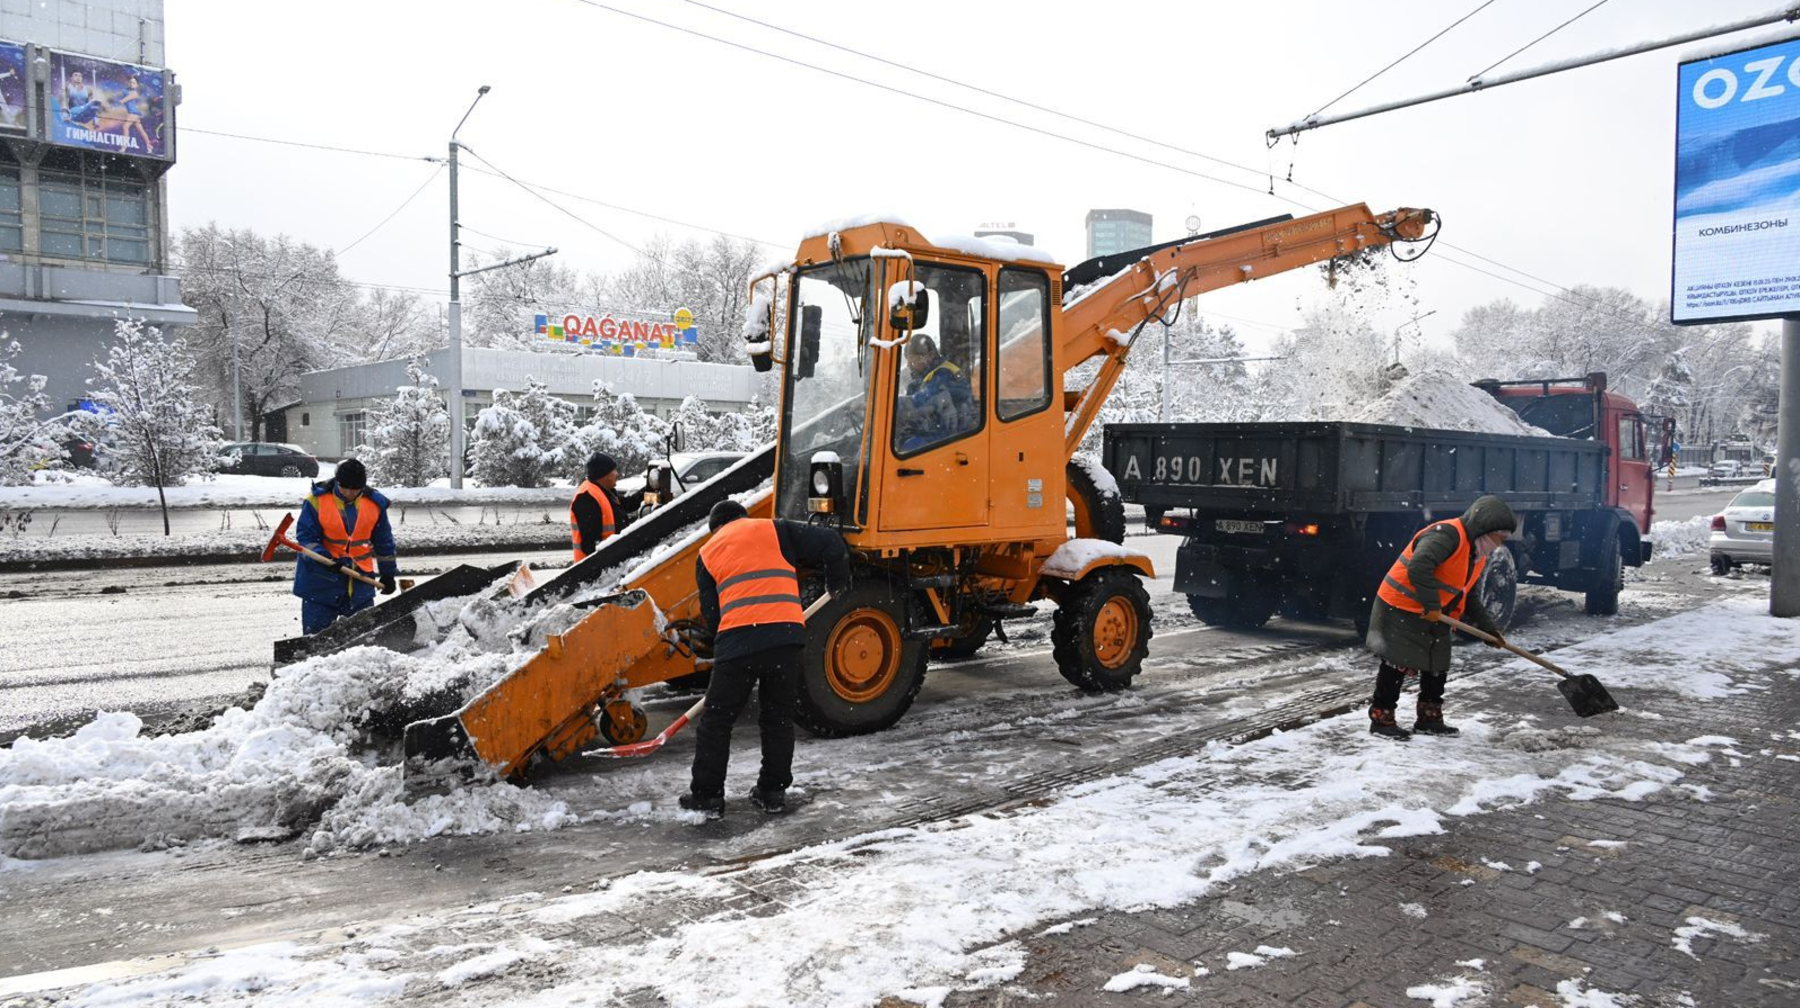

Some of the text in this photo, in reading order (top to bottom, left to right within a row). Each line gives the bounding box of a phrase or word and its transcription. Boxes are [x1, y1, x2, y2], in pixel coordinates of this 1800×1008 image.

[66, 127, 140, 149] ГИМНАСТИКА
[1698, 218, 1788, 237] КОМБИНЕЗОНЫ
[1124, 455, 1277, 486] A 890 XEN
[1226, 521, 1242, 531] 890
[1244, 522, 1261, 532] XEN
